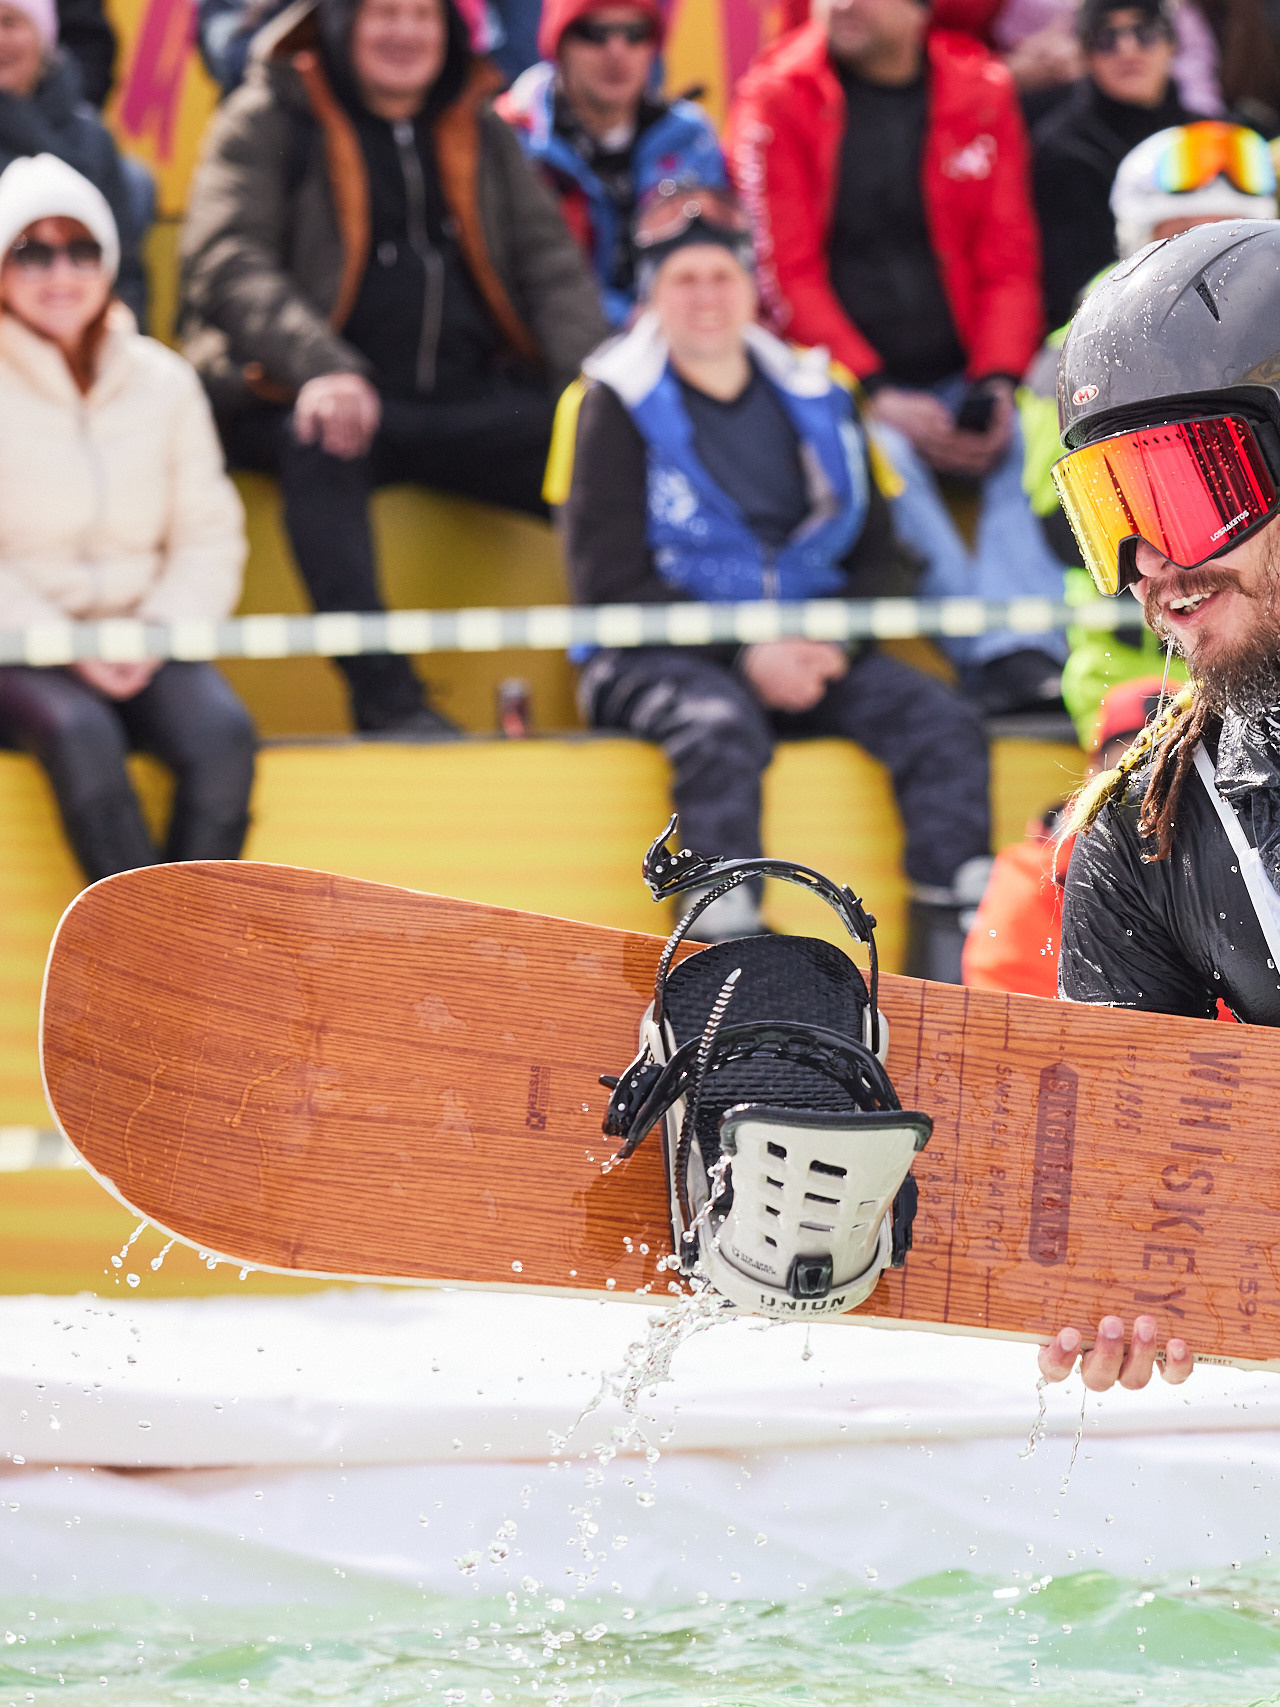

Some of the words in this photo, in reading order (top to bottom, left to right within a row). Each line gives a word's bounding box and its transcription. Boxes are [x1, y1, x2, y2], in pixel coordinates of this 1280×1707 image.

[528, 1066, 541, 1110] SYSTEM
[991, 1063, 1013, 1149] SMALL
[1042, 1078, 1073, 1173] SINGLE
[985, 1165, 1006, 1252] BATCH
[1037, 1182, 1064, 1254] MALT
[1133, 1050, 1242, 1319] WHISKEY
[760, 1294, 846, 1311] UNION
[1197, 1355, 1233, 1366] WHISKEY
